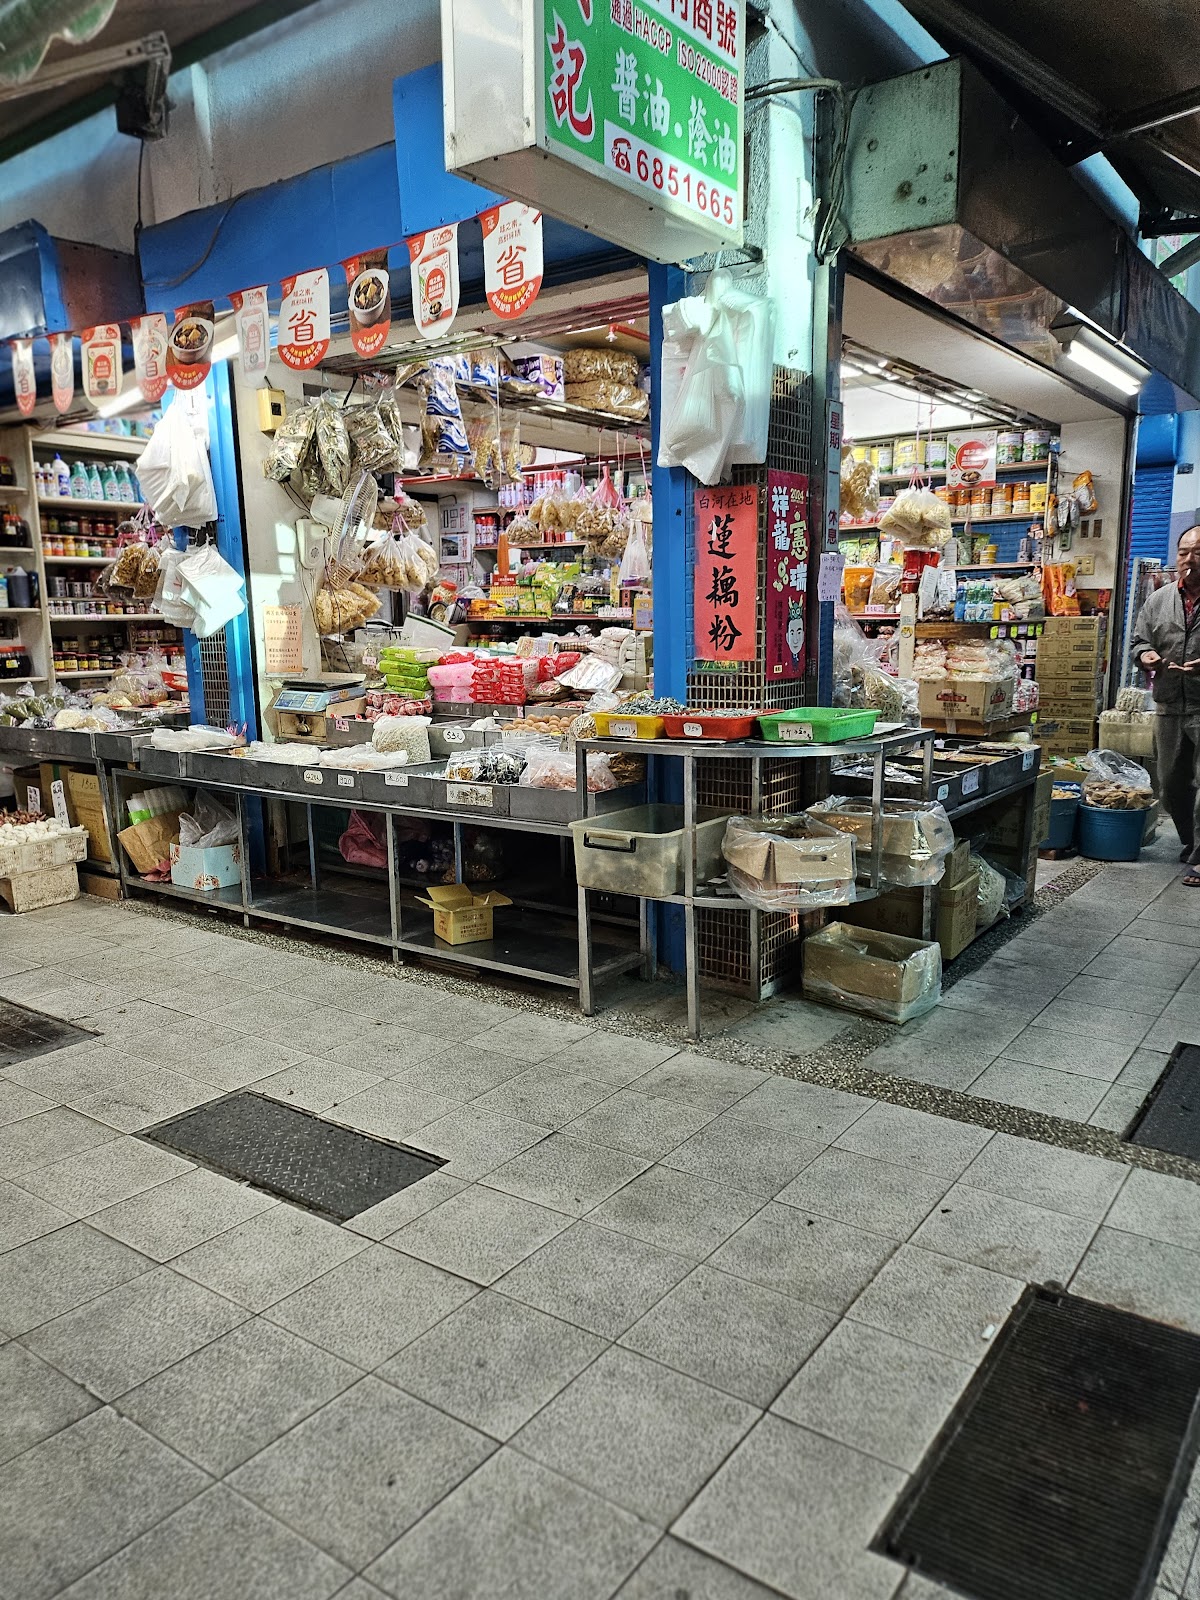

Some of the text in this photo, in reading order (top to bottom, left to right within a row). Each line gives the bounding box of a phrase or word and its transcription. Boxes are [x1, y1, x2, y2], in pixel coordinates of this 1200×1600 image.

[547, 0, 595, 143] 記
[636, 149, 734, 225] 6851665
[496, 245, 527, 285] 省
[288, 309, 317, 342] 省
[699, 490, 754, 510] 白河在地
[790, 487, 804, 500] 2024
[705, 513, 743, 652] 蓮藕粉
